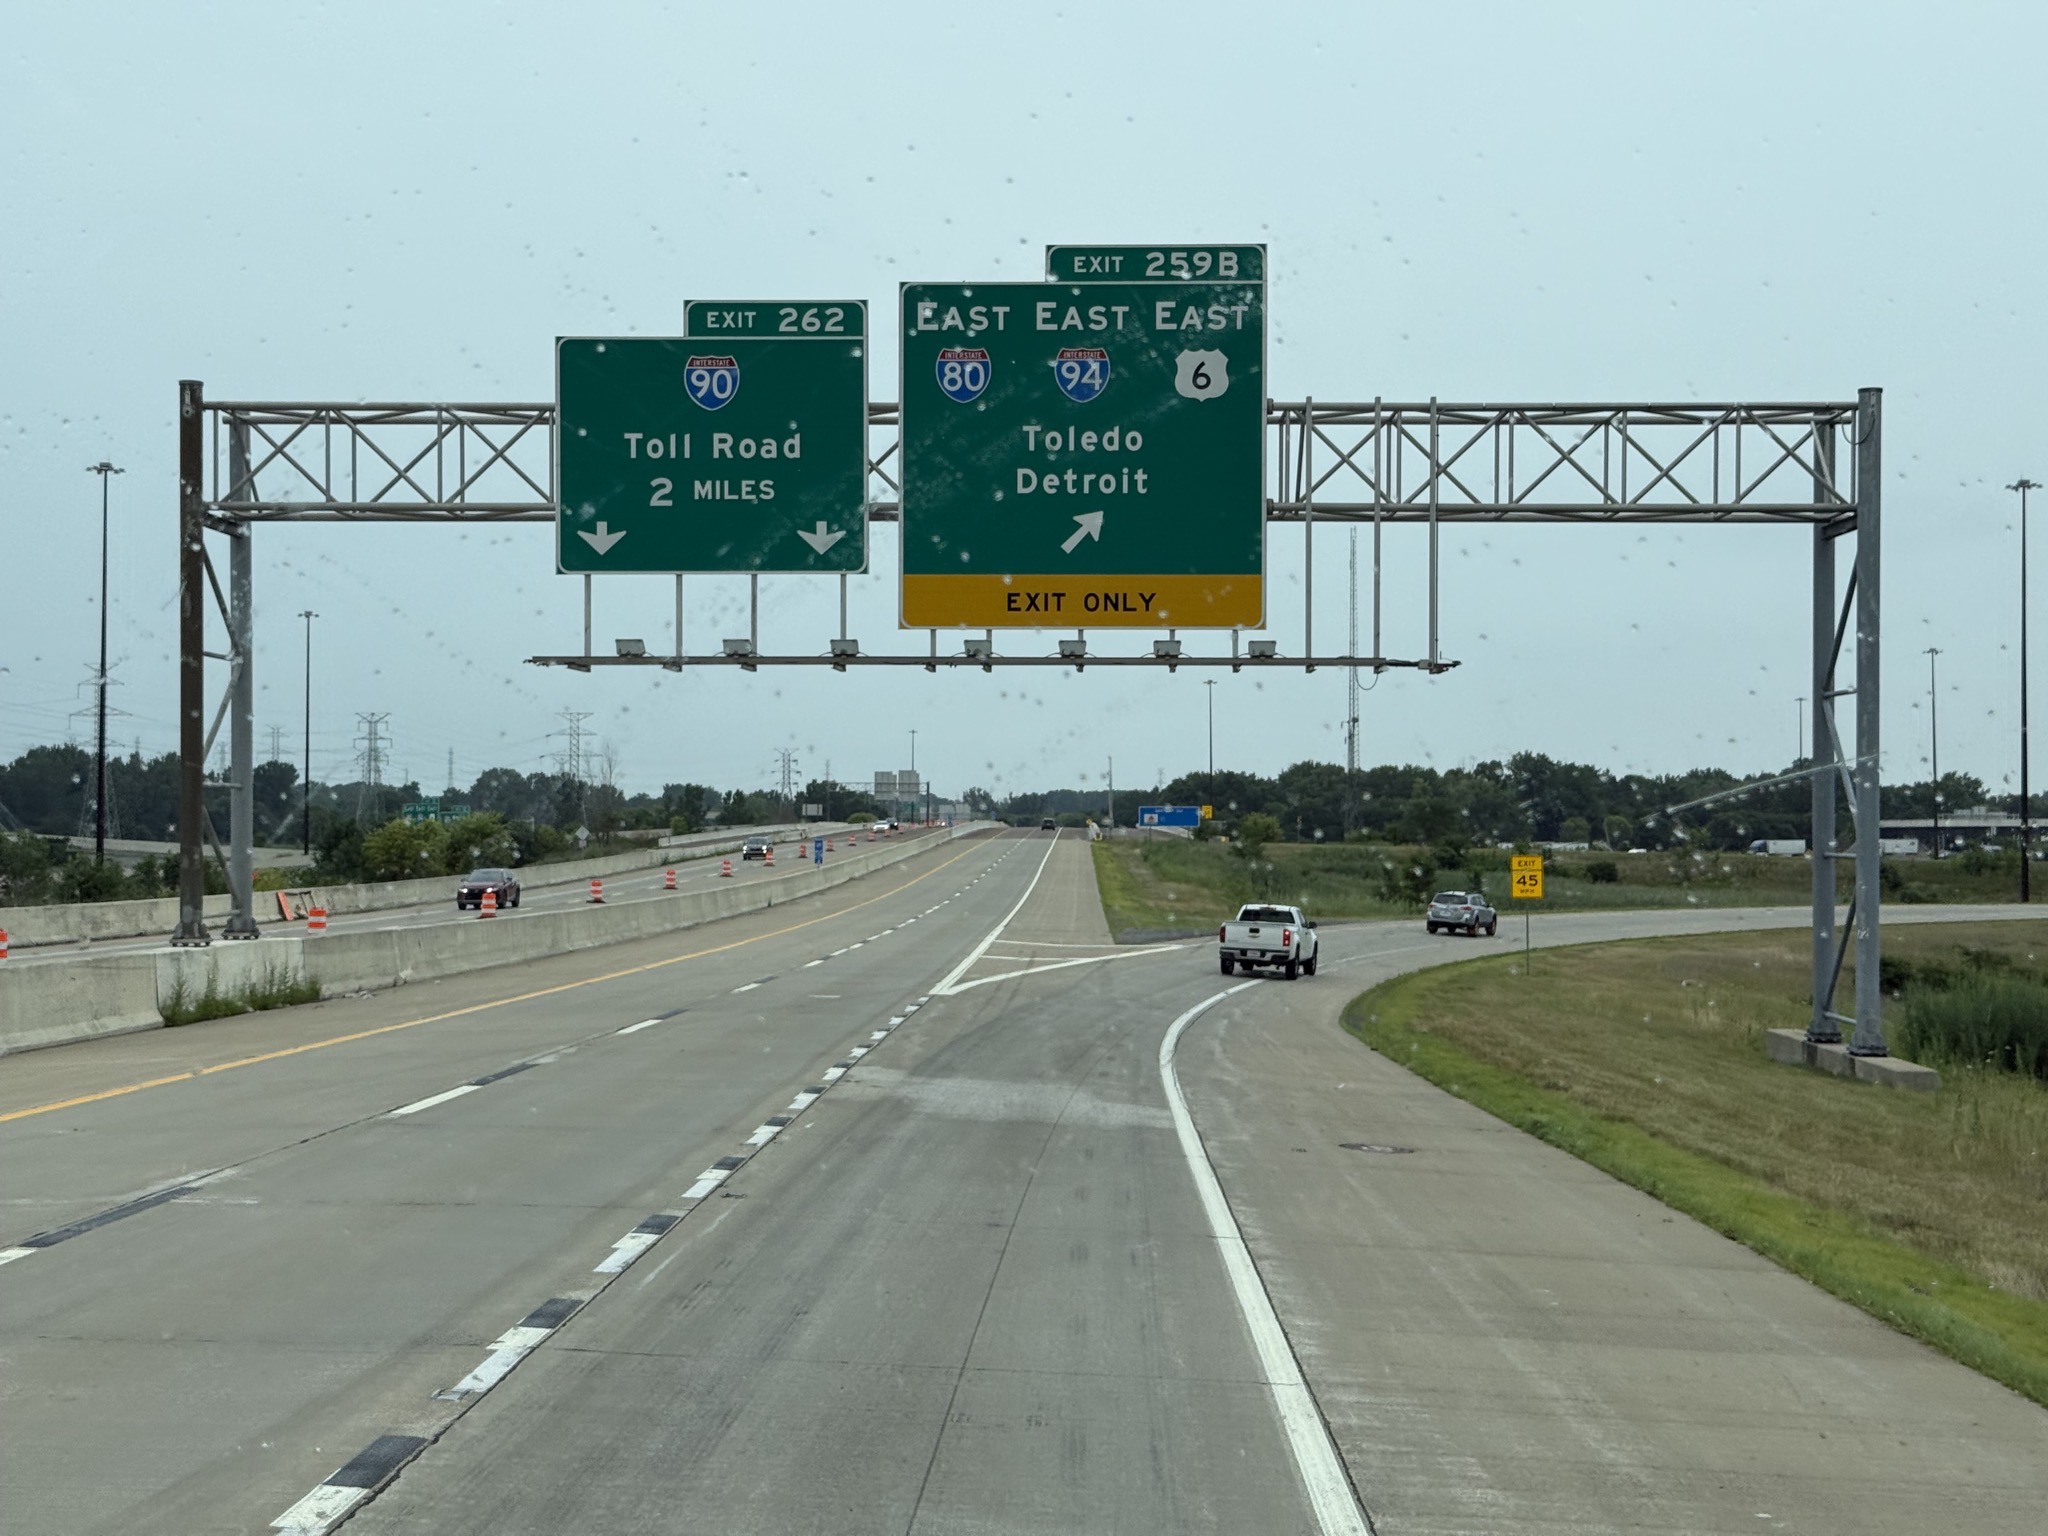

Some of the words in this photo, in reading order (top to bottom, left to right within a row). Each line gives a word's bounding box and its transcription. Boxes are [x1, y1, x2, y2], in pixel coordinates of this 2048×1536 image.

[1074, 256, 1124, 273] EXIT
[1145, 251, 1240, 277] 259B
[707, 311, 757, 328] EXIT
[778, 307, 844, 332] 262
[917, 301, 1010, 331] EAST
[1036, 301, 1130, 331] EAST
[1155, 300, 1250, 330] EAST
[693, 359, 731, 367] INTERSTATE
[944, 351, 982, 359] INTERSTATE
[1063, 351, 1101, 359] INTERSTATE
[690, 369, 733, 399] 90
[943, 361, 985, 391] 80
[1061, 361, 1102, 390] 94
[1191, 360, 1212, 390] 6
[623, 432, 690, 459] Toll
[713, 432, 802, 459] Road
[1022, 425, 1143, 452] Toledo
[649, 477, 673, 507] 2
[694, 479, 775, 500] MILES
[1017, 467, 1148, 494] Detroit
[1006, 591, 1067, 613] EXIT
[1083, 591, 1157, 613] ONLY
[1516, 874, 1538, 887] 45
